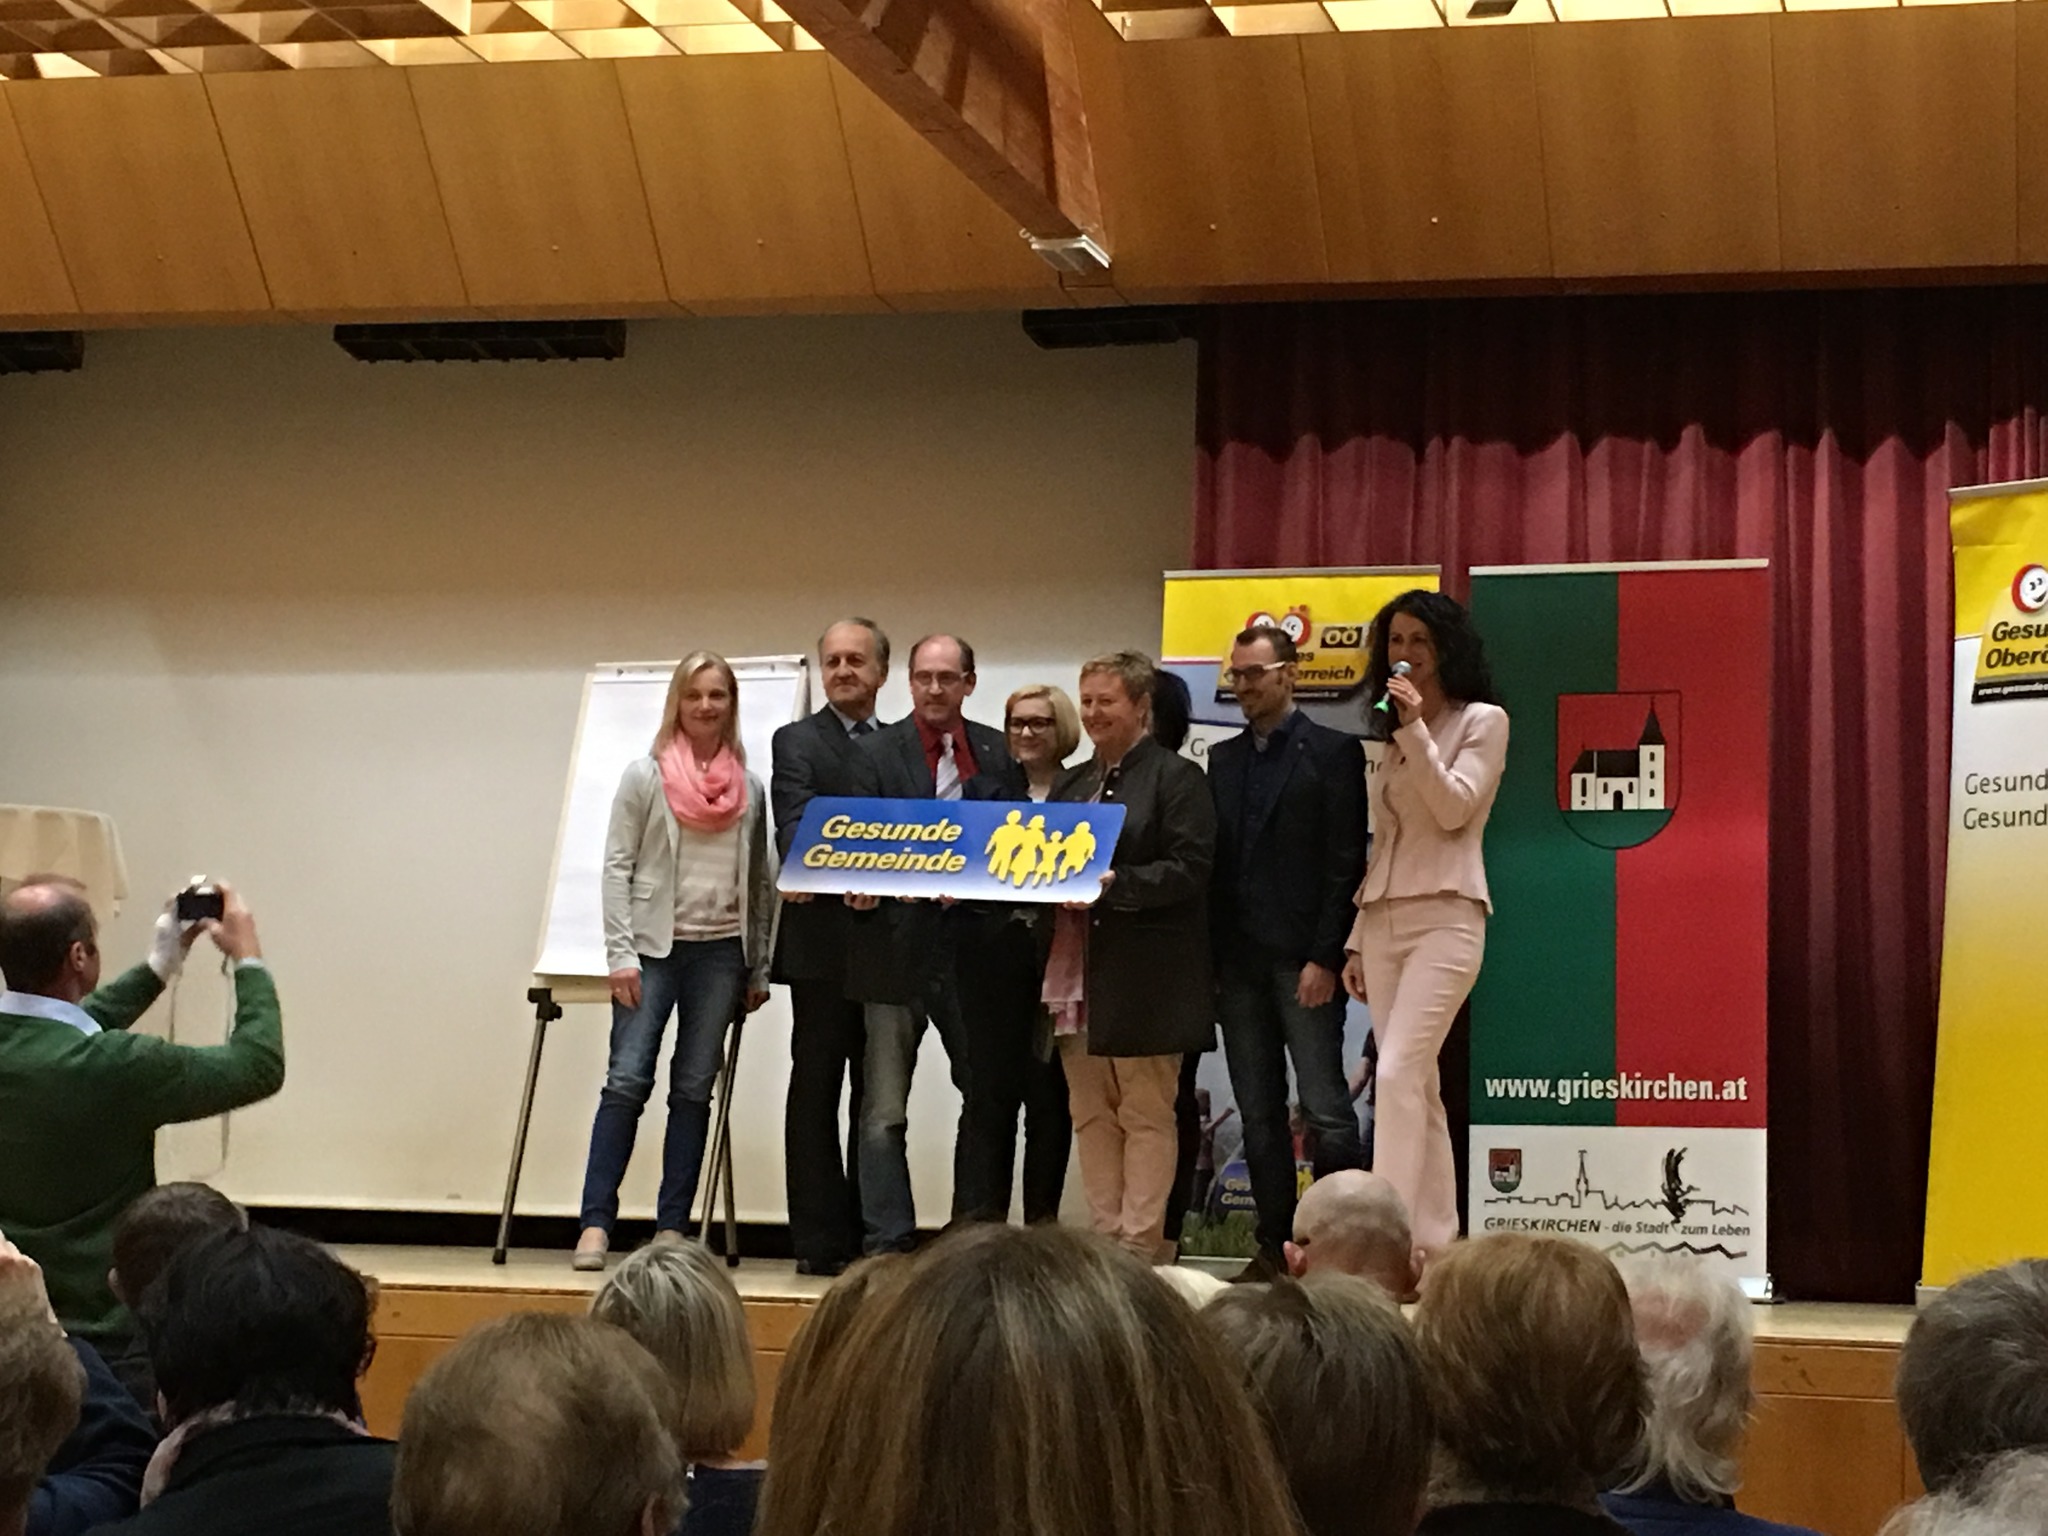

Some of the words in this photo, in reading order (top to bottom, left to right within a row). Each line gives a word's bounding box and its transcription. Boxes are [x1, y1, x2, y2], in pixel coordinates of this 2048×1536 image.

[1324, 627, 1359, 646] OÖ
[821, 814, 963, 842] Gesunde
[803, 844, 967, 873] Gemeinde
[1485, 1072, 1748, 1105] www.grieskirchen.at
[1484, 1217, 1601, 1234] GRIESKIRCHEN
[1612, 1220, 1632, 1234] die
[1635, 1221, 1669, 1235] Stadt
[1681, 1225, 1708, 1236] zum
[1712, 1224, 1750, 1237] Leben
